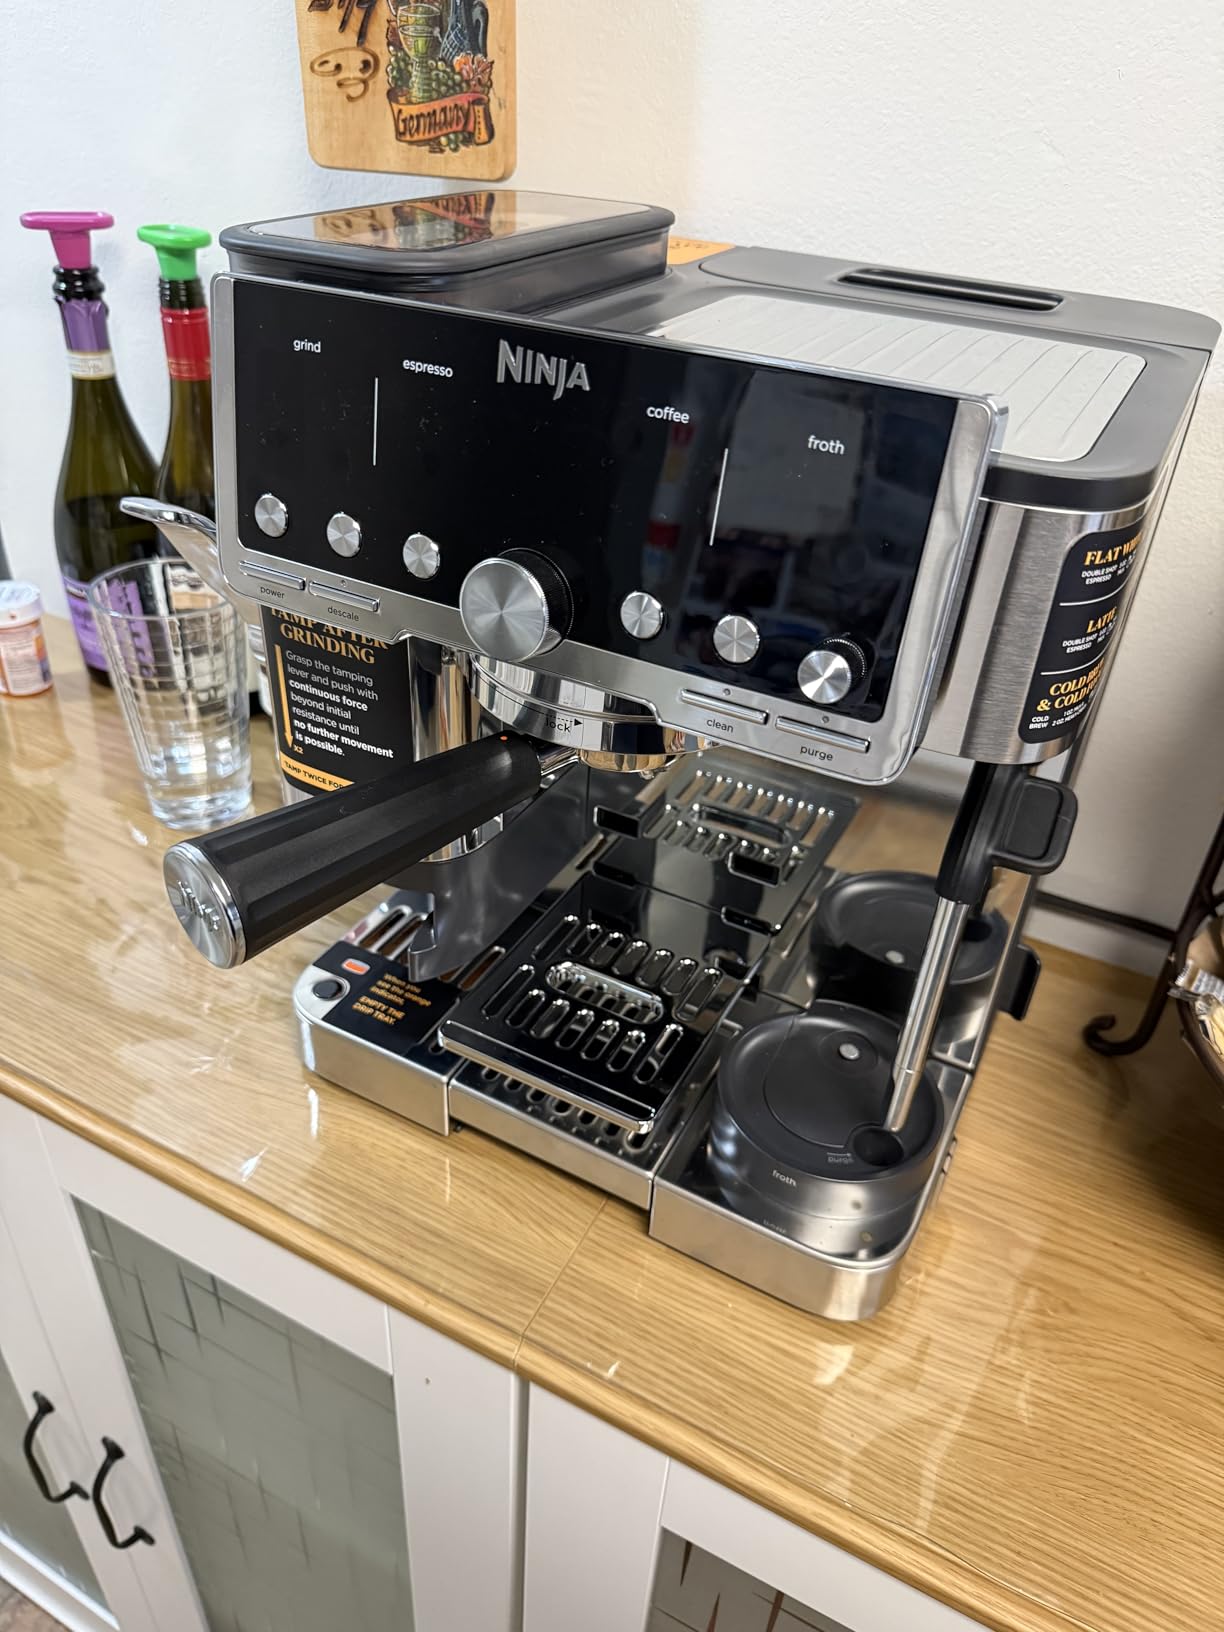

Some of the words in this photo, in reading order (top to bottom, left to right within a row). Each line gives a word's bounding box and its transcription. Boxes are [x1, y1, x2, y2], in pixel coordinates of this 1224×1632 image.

[396, 102, 472, 139] Germany
[293, 339, 321, 353] grind
[403, 358, 453, 378] espresso
[497, 338, 590, 400] NINJA
[646, 406, 690, 424] coffee
[807, 435, 845, 455] froth
[1083, 546, 1122, 566] FLAT
[1081, 568, 1105, 578] DOUBLE
[1085, 574, 1112, 585] ESPRESSO
[260, 586, 285, 599] power
[327, 606, 360, 622] descale
[280, 623, 375, 664] GRINDING
[1062, 637, 1085, 647] DOUBLE
[1066, 642, 1092, 653] ESPRESSO
[286, 650, 313, 667] Grasp
[314, 660, 330, 673] the
[332, 666, 373, 687] tamping
[287, 663, 309, 679] lever
[311, 674, 329, 686] and
[331, 680, 355, 694] push
[357, 688, 379, 701] with
[1049, 675, 1087, 697] COLD
[288, 679, 341, 703] continuous
[342, 695, 368, 712] force
[290, 691, 325, 711] beyond
[326, 703, 352, 720] initial
[1036, 699, 1052, 711] &
[1054, 687, 1087, 710] COLD
[292, 706, 337, 728] resistance
[338, 721, 360, 735] until
[546, 717, 571, 733] lock
[706, 718, 734, 734] clean
[1028, 722, 1048, 730] BREW
[1032, 715, 1049, 723] COLD
[293, 719, 306, 730] no
[307, 723, 340, 741] further
[341, 735, 394, 759] movement
[295, 730, 303, 741] is
[304, 735, 345, 756] possible.
[800, 744, 834, 761] purge
[284, 761, 302, 774] TAMP
[302, 768, 327, 785] TWICE
[352, 1002, 374, 1015] DRIP
[359, 995, 388, 1012] EMPTY
[387, 1007, 406, 1020] THE
[772, 1169, 798, 1188] froth
